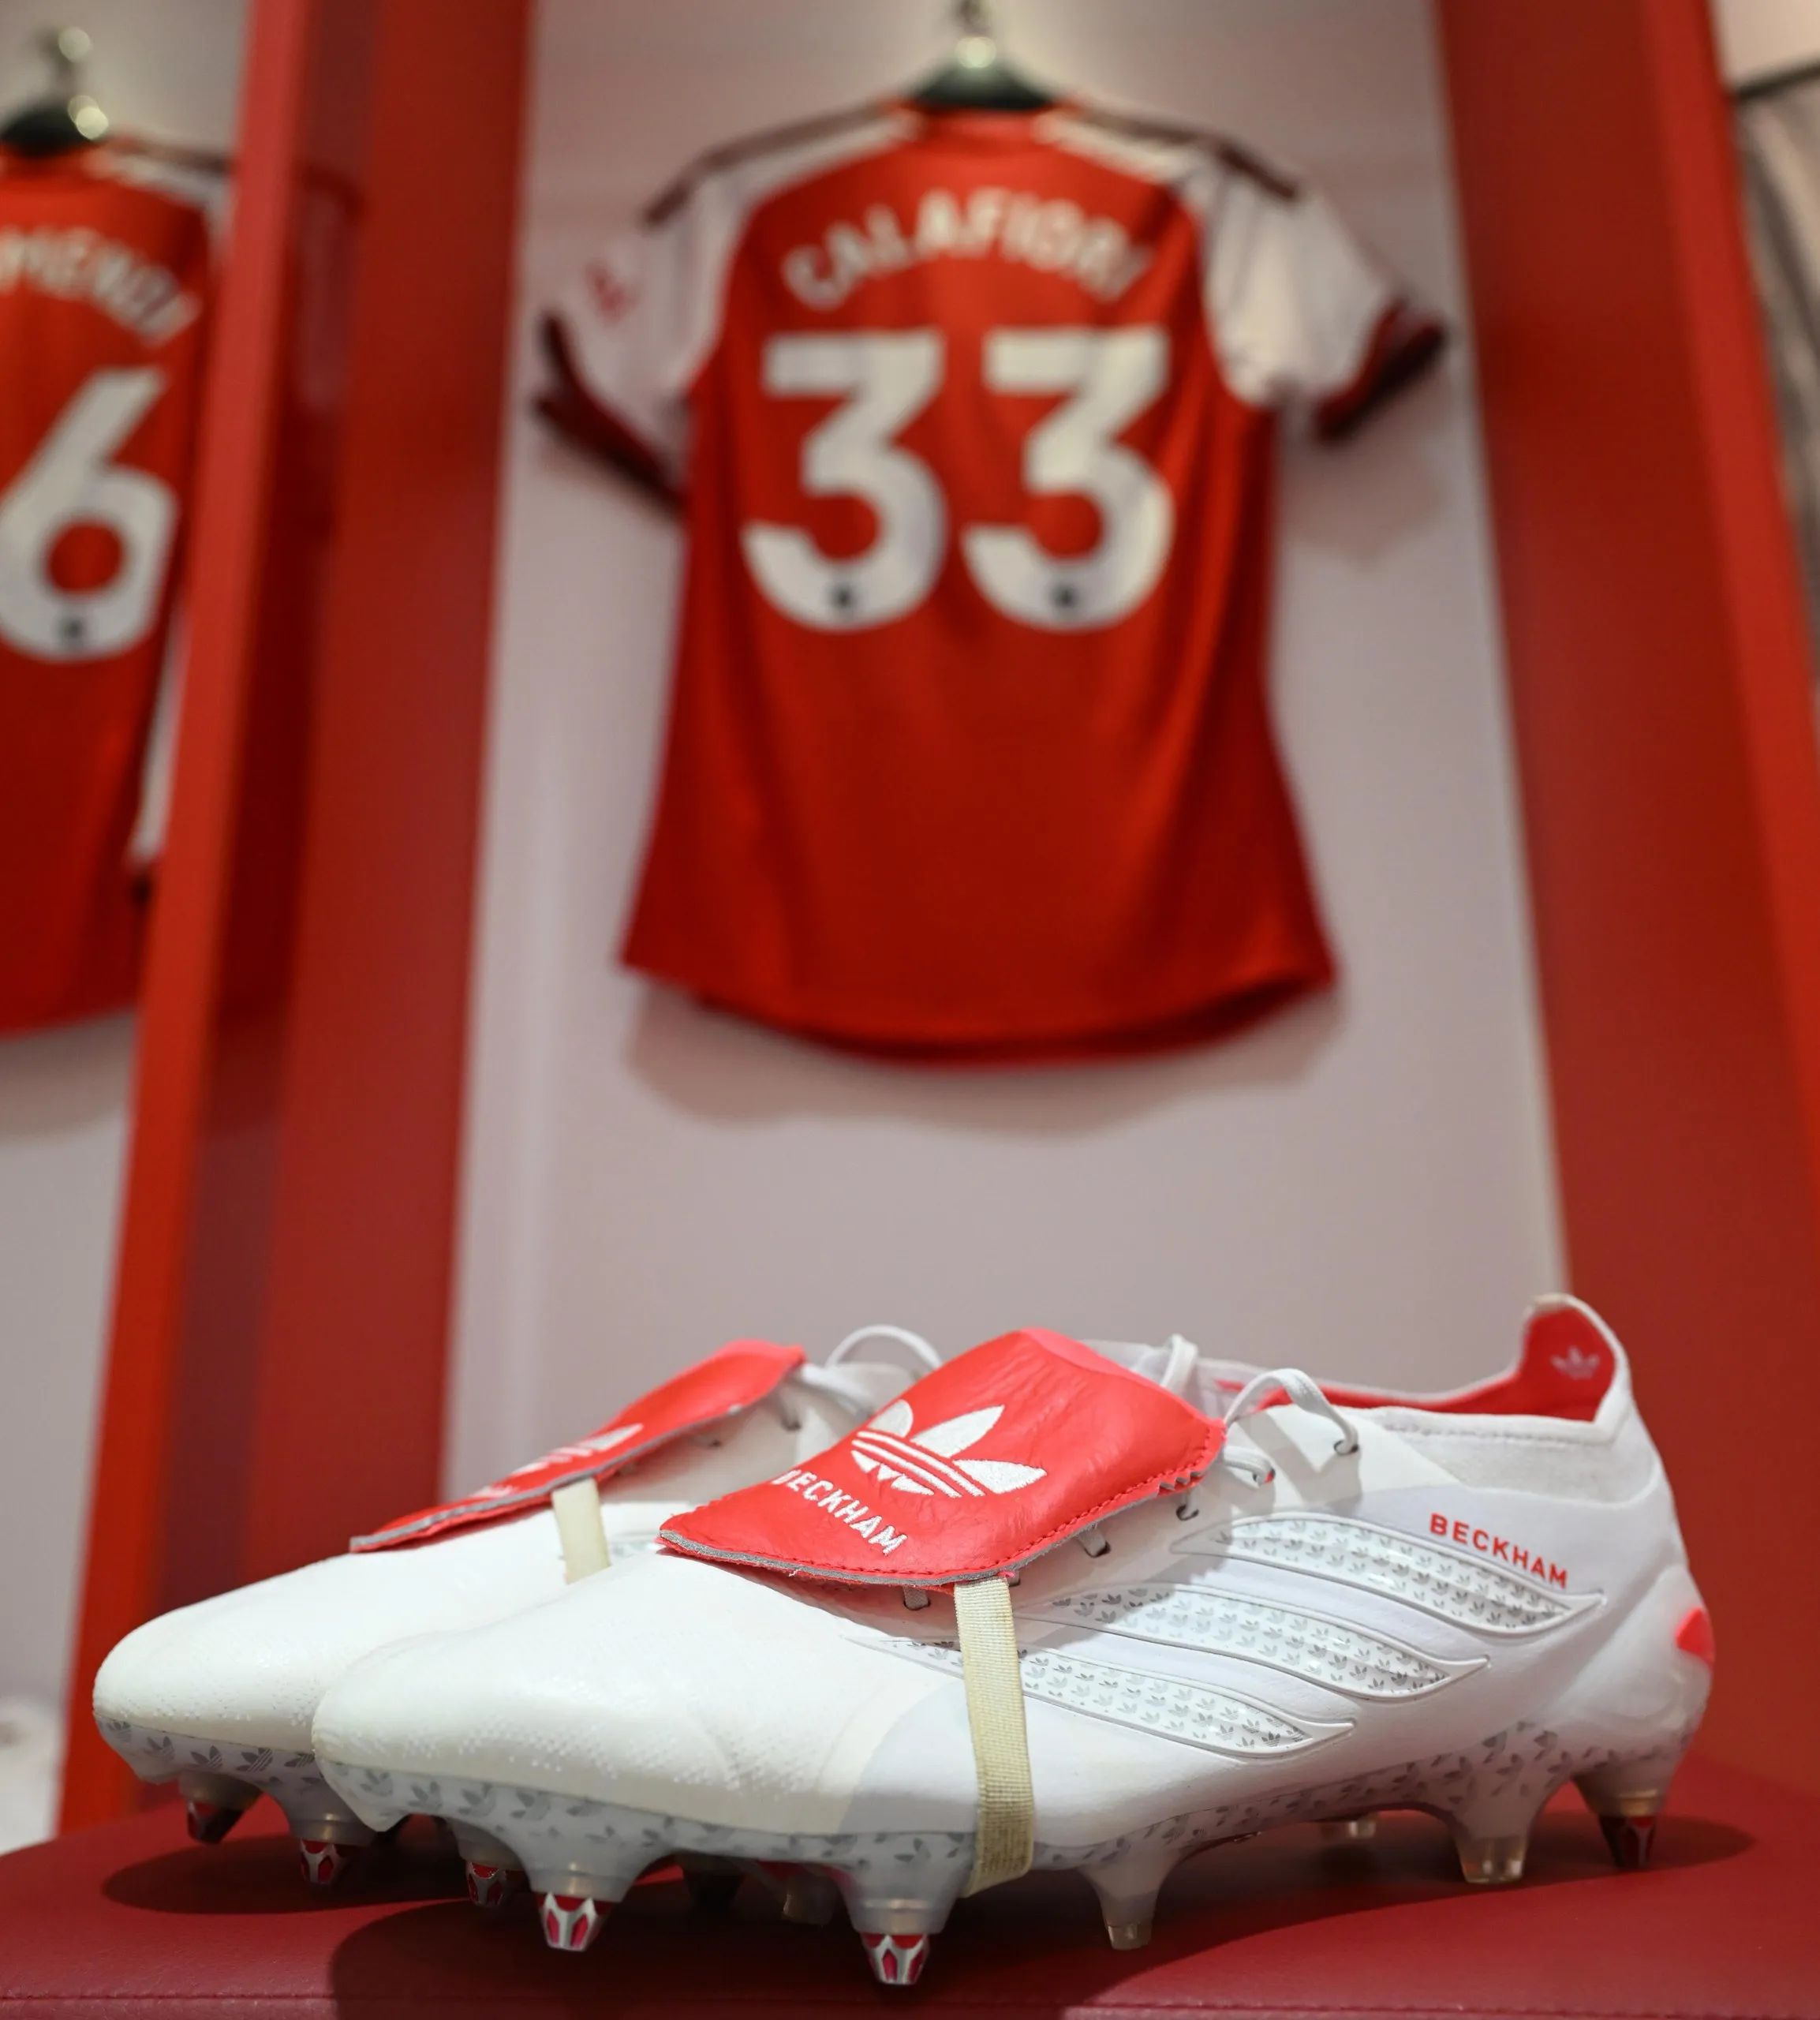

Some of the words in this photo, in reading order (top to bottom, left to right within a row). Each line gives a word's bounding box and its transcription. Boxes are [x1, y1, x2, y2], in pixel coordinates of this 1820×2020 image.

[0, 367, 178, 661] 6
[742, 331, 1174, 628] 33
[1429, 1513, 1568, 1589] BECKHAM
